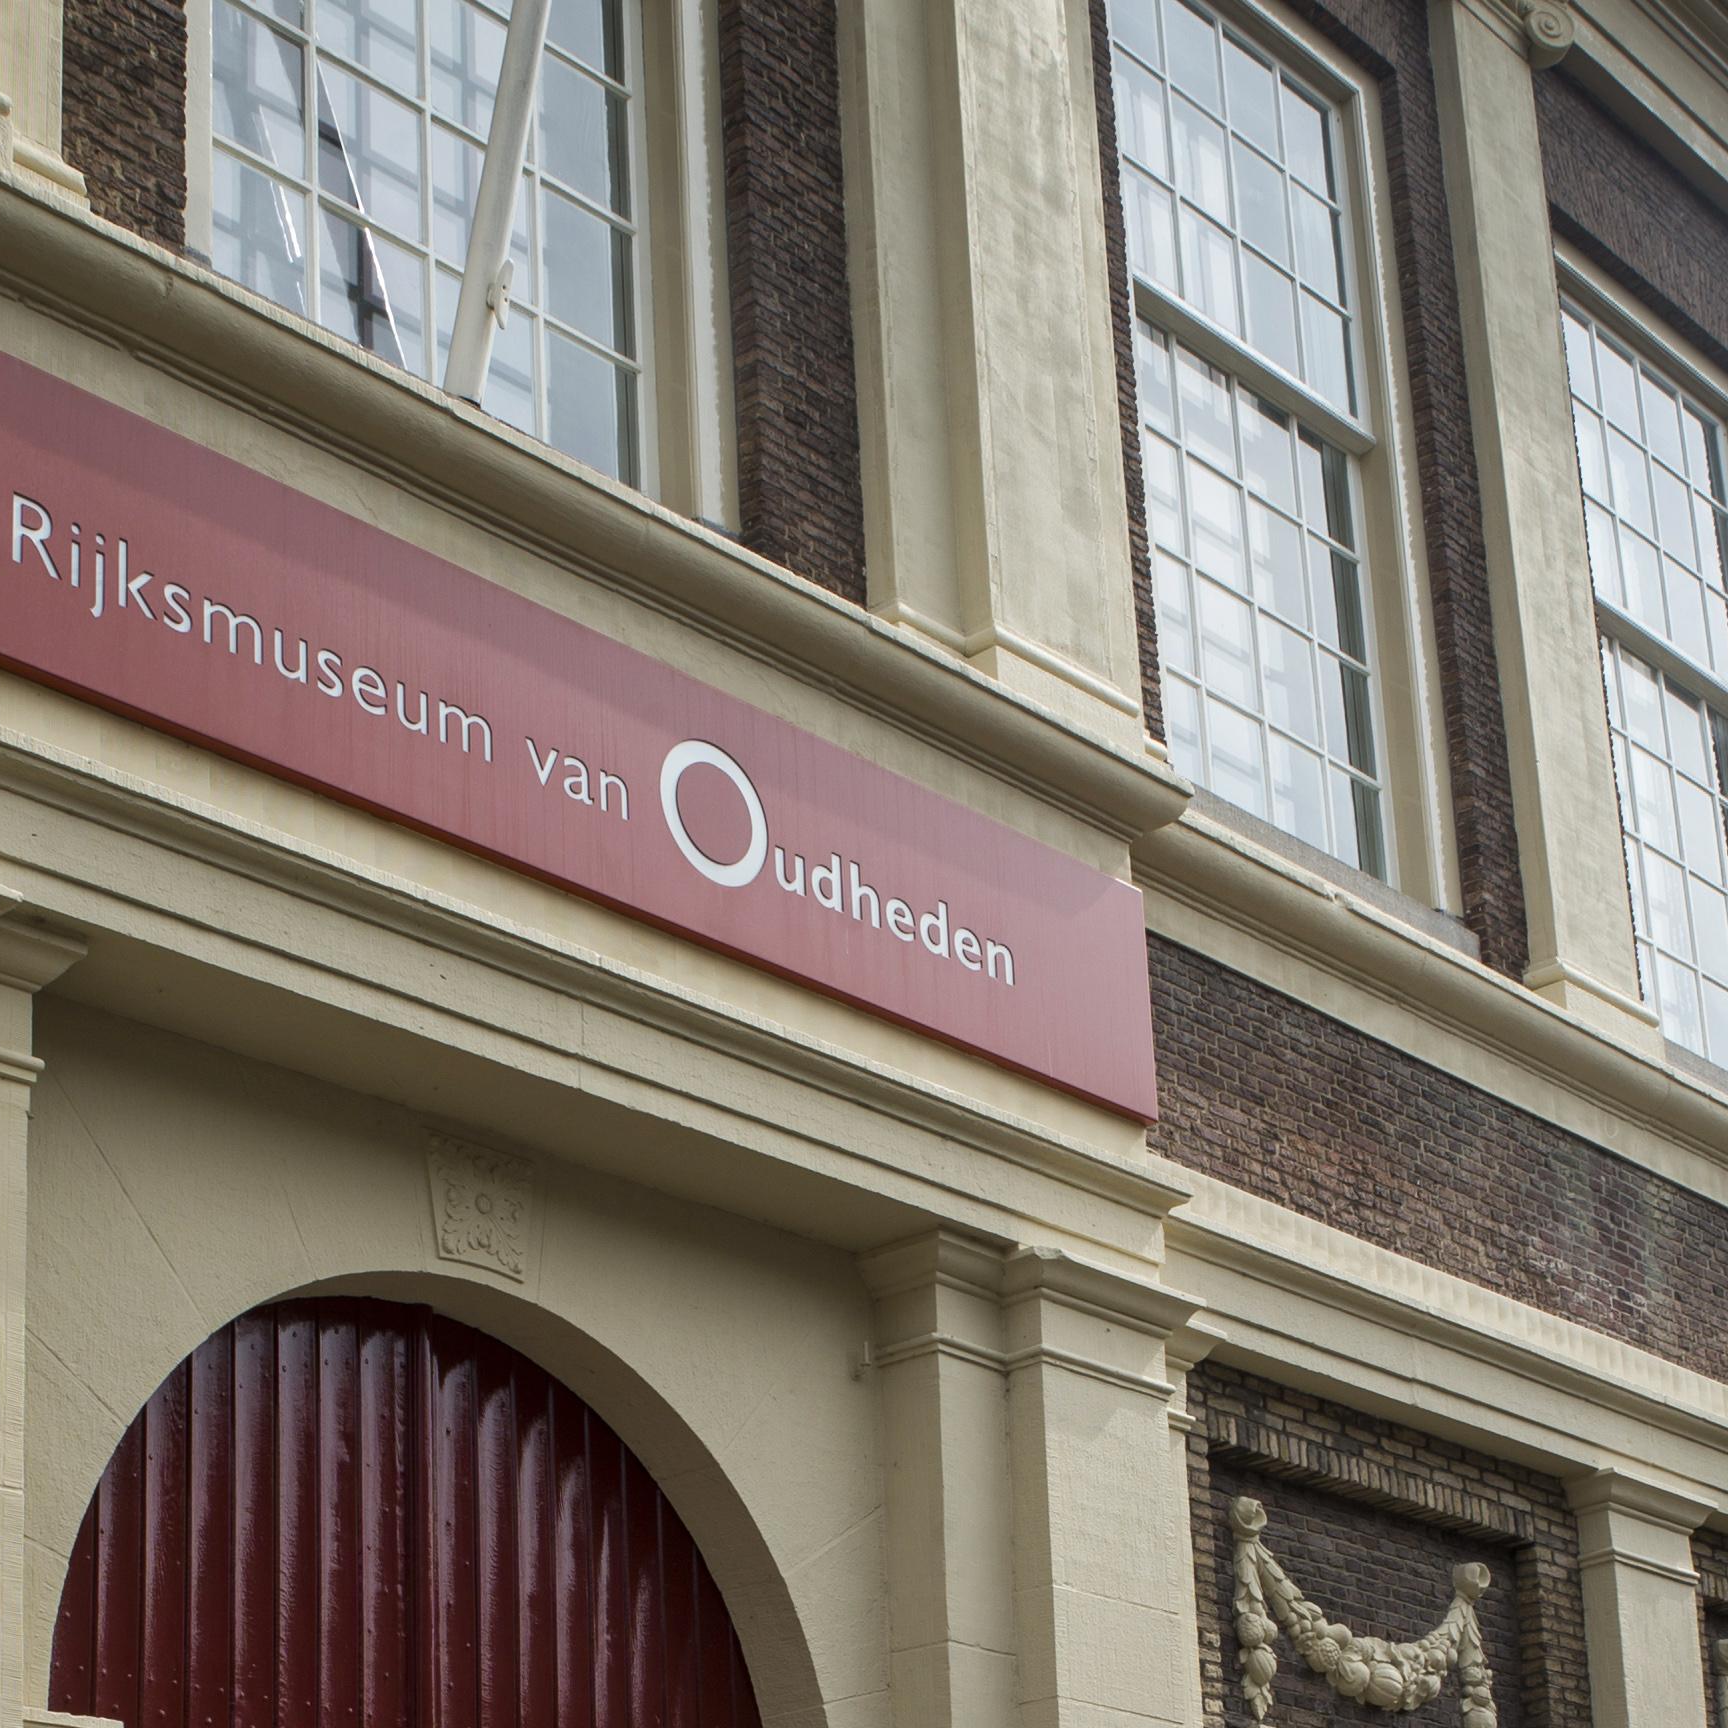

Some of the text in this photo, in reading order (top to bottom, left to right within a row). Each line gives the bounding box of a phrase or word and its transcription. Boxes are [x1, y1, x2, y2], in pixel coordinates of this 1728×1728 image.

[10, 490, 1017, 988] Rijksmuseum van Oudheden
